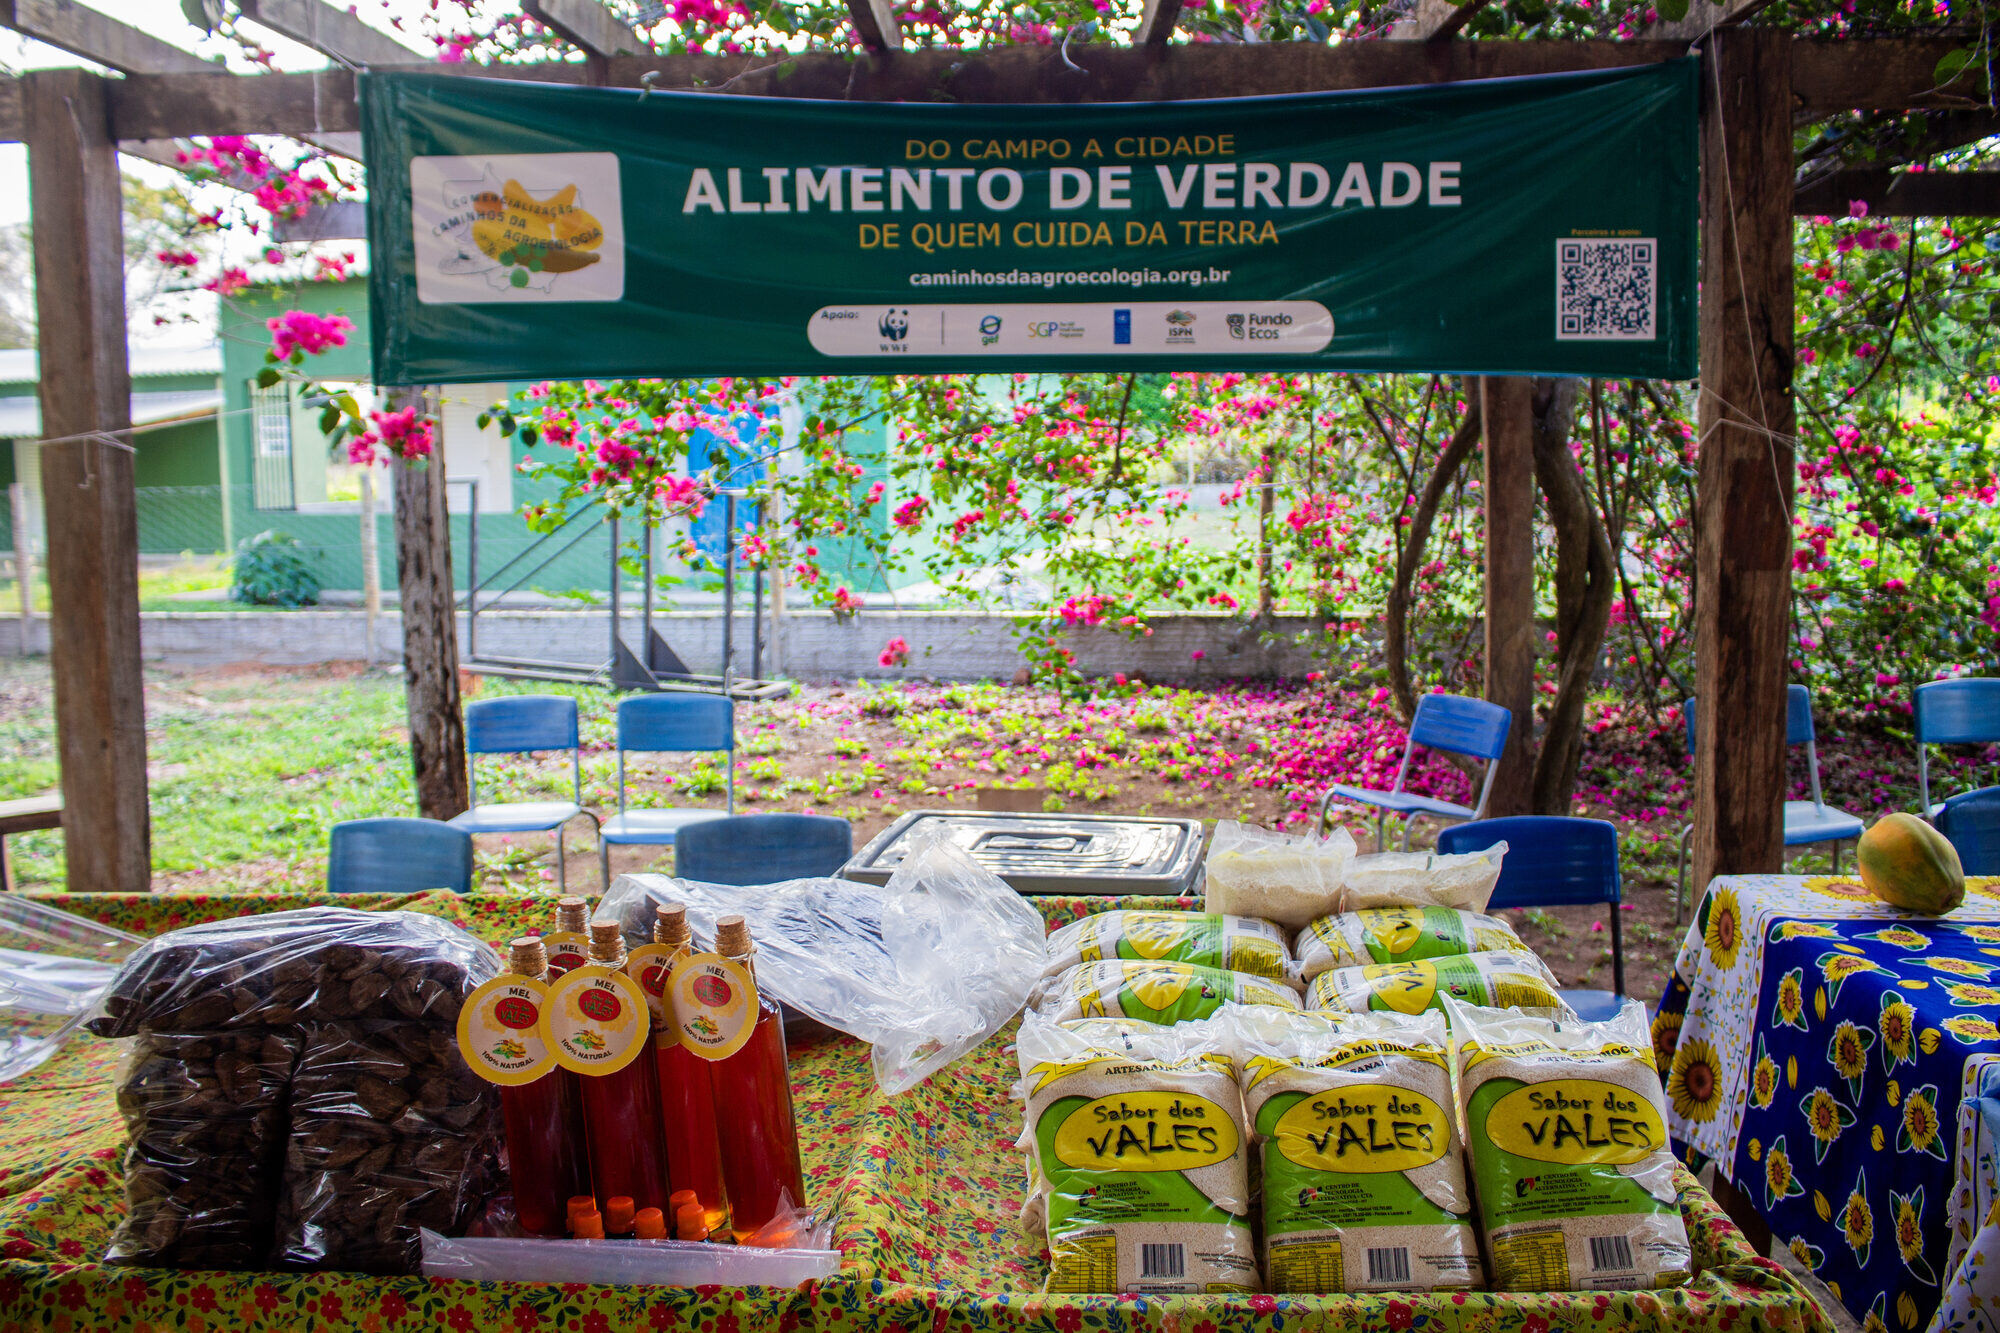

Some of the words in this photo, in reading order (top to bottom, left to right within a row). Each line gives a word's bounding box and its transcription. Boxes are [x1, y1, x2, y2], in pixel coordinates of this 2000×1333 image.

[905, 138, 951, 160] DO
[962, 138, 1072, 160] CAMPO
[1083, 137, 1104, 158] A
[1114, 134, 1236, 158] CIDADE
[682, 166, 1024, 214] ALIMENTO
[1049, 165, 1133, 210] DE
[1155, 161, 1463, 209] VERDADE
[432, 208, 505, 237] CAMINHOS
[508, 215, 528, 230] DA
[502, 227, 603, 251] AGROECOLOGIA
[859, 222, 900, 249] DE
[910, 221, 1001, 254] QUEM
[1012, 221, 1114, 248] CUIDA
[1125, 220, 1169, 246] DA
[1178, 219, 1280, 245] TERRA
[909, 266, 1232, 288] caminhosdaagroecologia.org.br
[821, 309, 859, 321] Apoio:
[1248, 312, 1293, 326] Fundo
[981, 334, 1000, 346] gef
[1027, 321, 1059, 339] SGP
[1168, 327, 1193, 337] ISPN
[1249, 327, 1280, 340] Ecos
[559, 944, 580, 954] MEL
[706, 965, 726, 979] MEL
[508, 987, 531, 999] MEL
[594, 979, 616, 993] MEL
[500, 1009, 531, 1025] VALES
[584, 1000, 614, 1018] VALES
[683, 1023, 698, 1040] 100%
[697, 1035, 726, 1045] NATURAL
[561, 1038, 578, 1055] 100%
[577, 1049, 613, 1061] NATURAL
[1335, 1051, 1351, 1063] de
[481, 1050, 499, 1067] 100%
[499, 1057, 535, 1070] NATURAL
[1093, 1102, 1160, 1124] Sabor
[1168, 1099, 1206, 1120] dos
[1312, 1097, 1379, 1120] Sabor
[1386, 1095, 1422, 1116] dos
[1529, 1089, 1592, 1112] Sabor
[1603, 1091, 1639, 1114] dos
[1087, 1120, 1218, 1159] VALES
[1307, 1117, 1434, 1158] VALES
[1522, 1112, 1652, 1150] VALES
[1542, 1176, 1583, 1185] TECNOLOGIA
